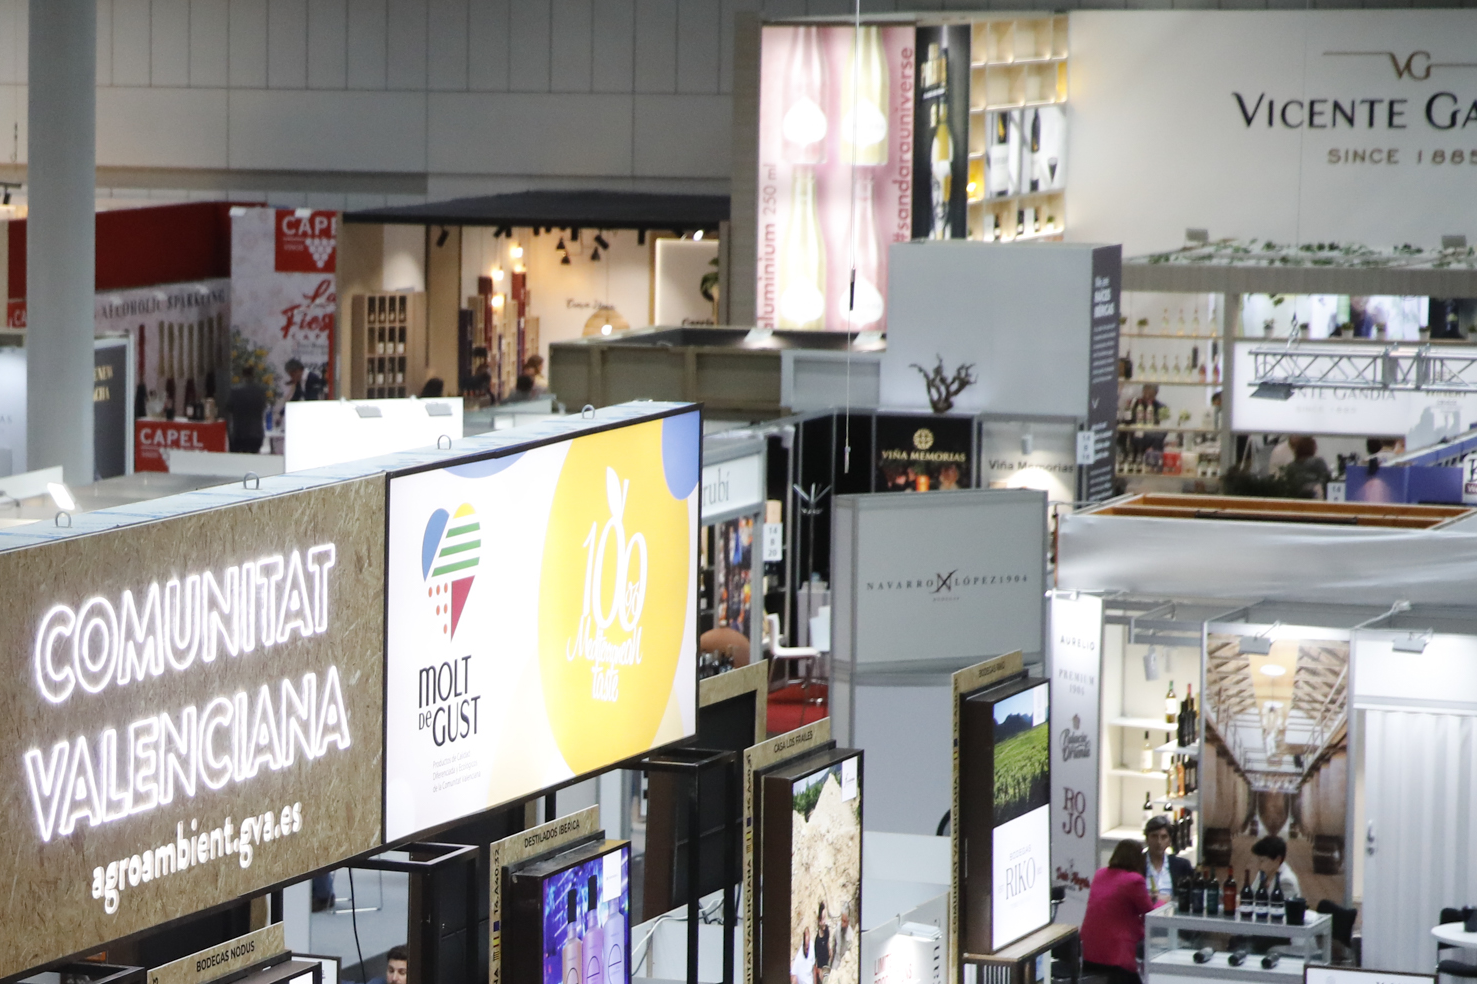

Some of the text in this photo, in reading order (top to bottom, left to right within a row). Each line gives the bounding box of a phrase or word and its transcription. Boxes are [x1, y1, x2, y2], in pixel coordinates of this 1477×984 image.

[1231, 91, 1408, 129] VICENTE
[894, 47, 913, 242] #sandarauniverse
[1327, 149, 1400, 165] SINCE
[762, 185, 776, 214] 250
[757, 223, 775, 328] aluminium
[139, 427, 205, 448] CAPEL
[882, 449, 966, 462] VIÑA MEMORIAS
[989, 459, 1015, 471] Viña
[768, 526, 778, 535] 14
[767, 549, 778, 558] 20
[866, 578, 934, 591] NAVARRO
[34, 543, 336, 703] COMUNITAT
[1060, 635, 1096, 651] AURELIO
[590, 663, 620, 703] taste
[432, 695, 481, 747] GUST
[25, 665, 351, 842] VALENCIANA
[774, 730, 813, 754] CASA LOS FRAILES
[524, 819, 580, 848] DESTILADOS IBERICA
[91, 802, 302, 914] agroambient.gva.es
[1006, 857, 1036, 900] RIKO
[196, 941, 256, 973] BODEGAS NODUS
